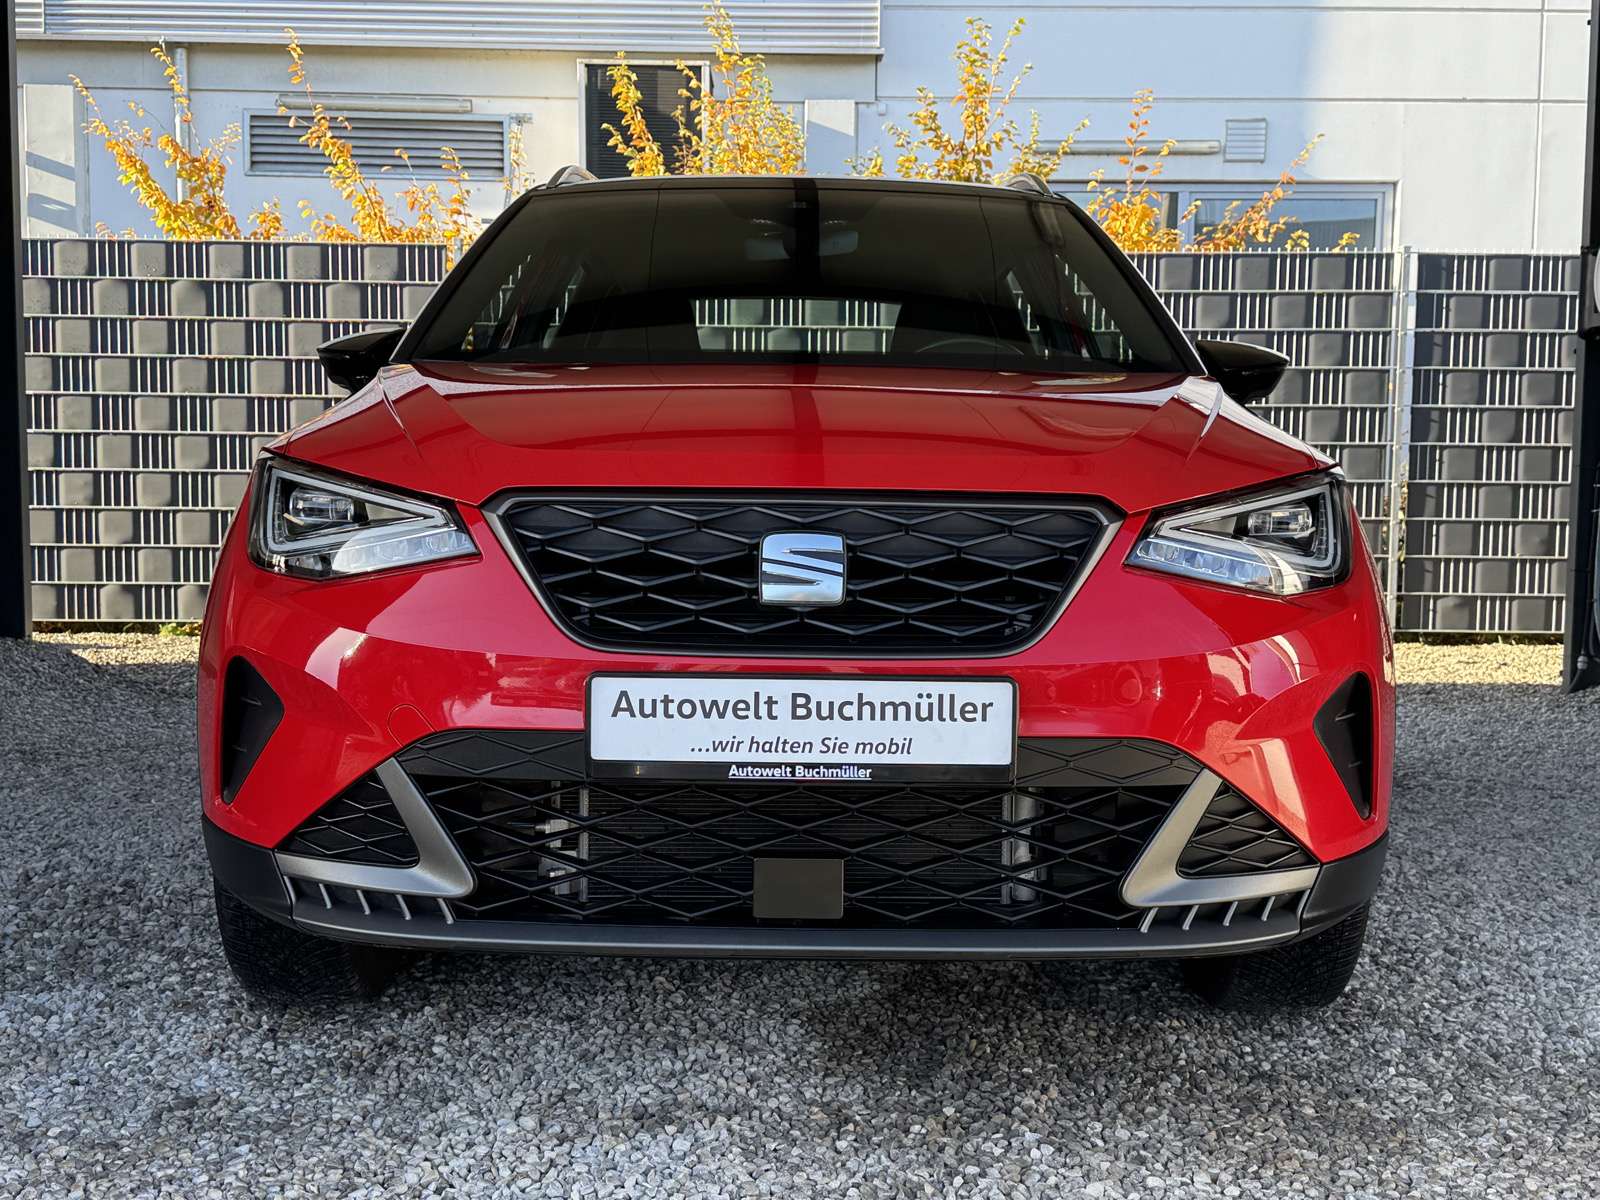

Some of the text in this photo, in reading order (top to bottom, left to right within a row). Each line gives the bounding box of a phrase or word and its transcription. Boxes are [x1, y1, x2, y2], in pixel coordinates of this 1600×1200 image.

[610, 690, 993, 722] Autowelt Buchmüller
[747, 736, 813, 754] halten
[819, 737, 849, 754] Sie
[854, 737, 913, 755] mobil
[728, 764, 872, 778] Autowelt Buchmüller
